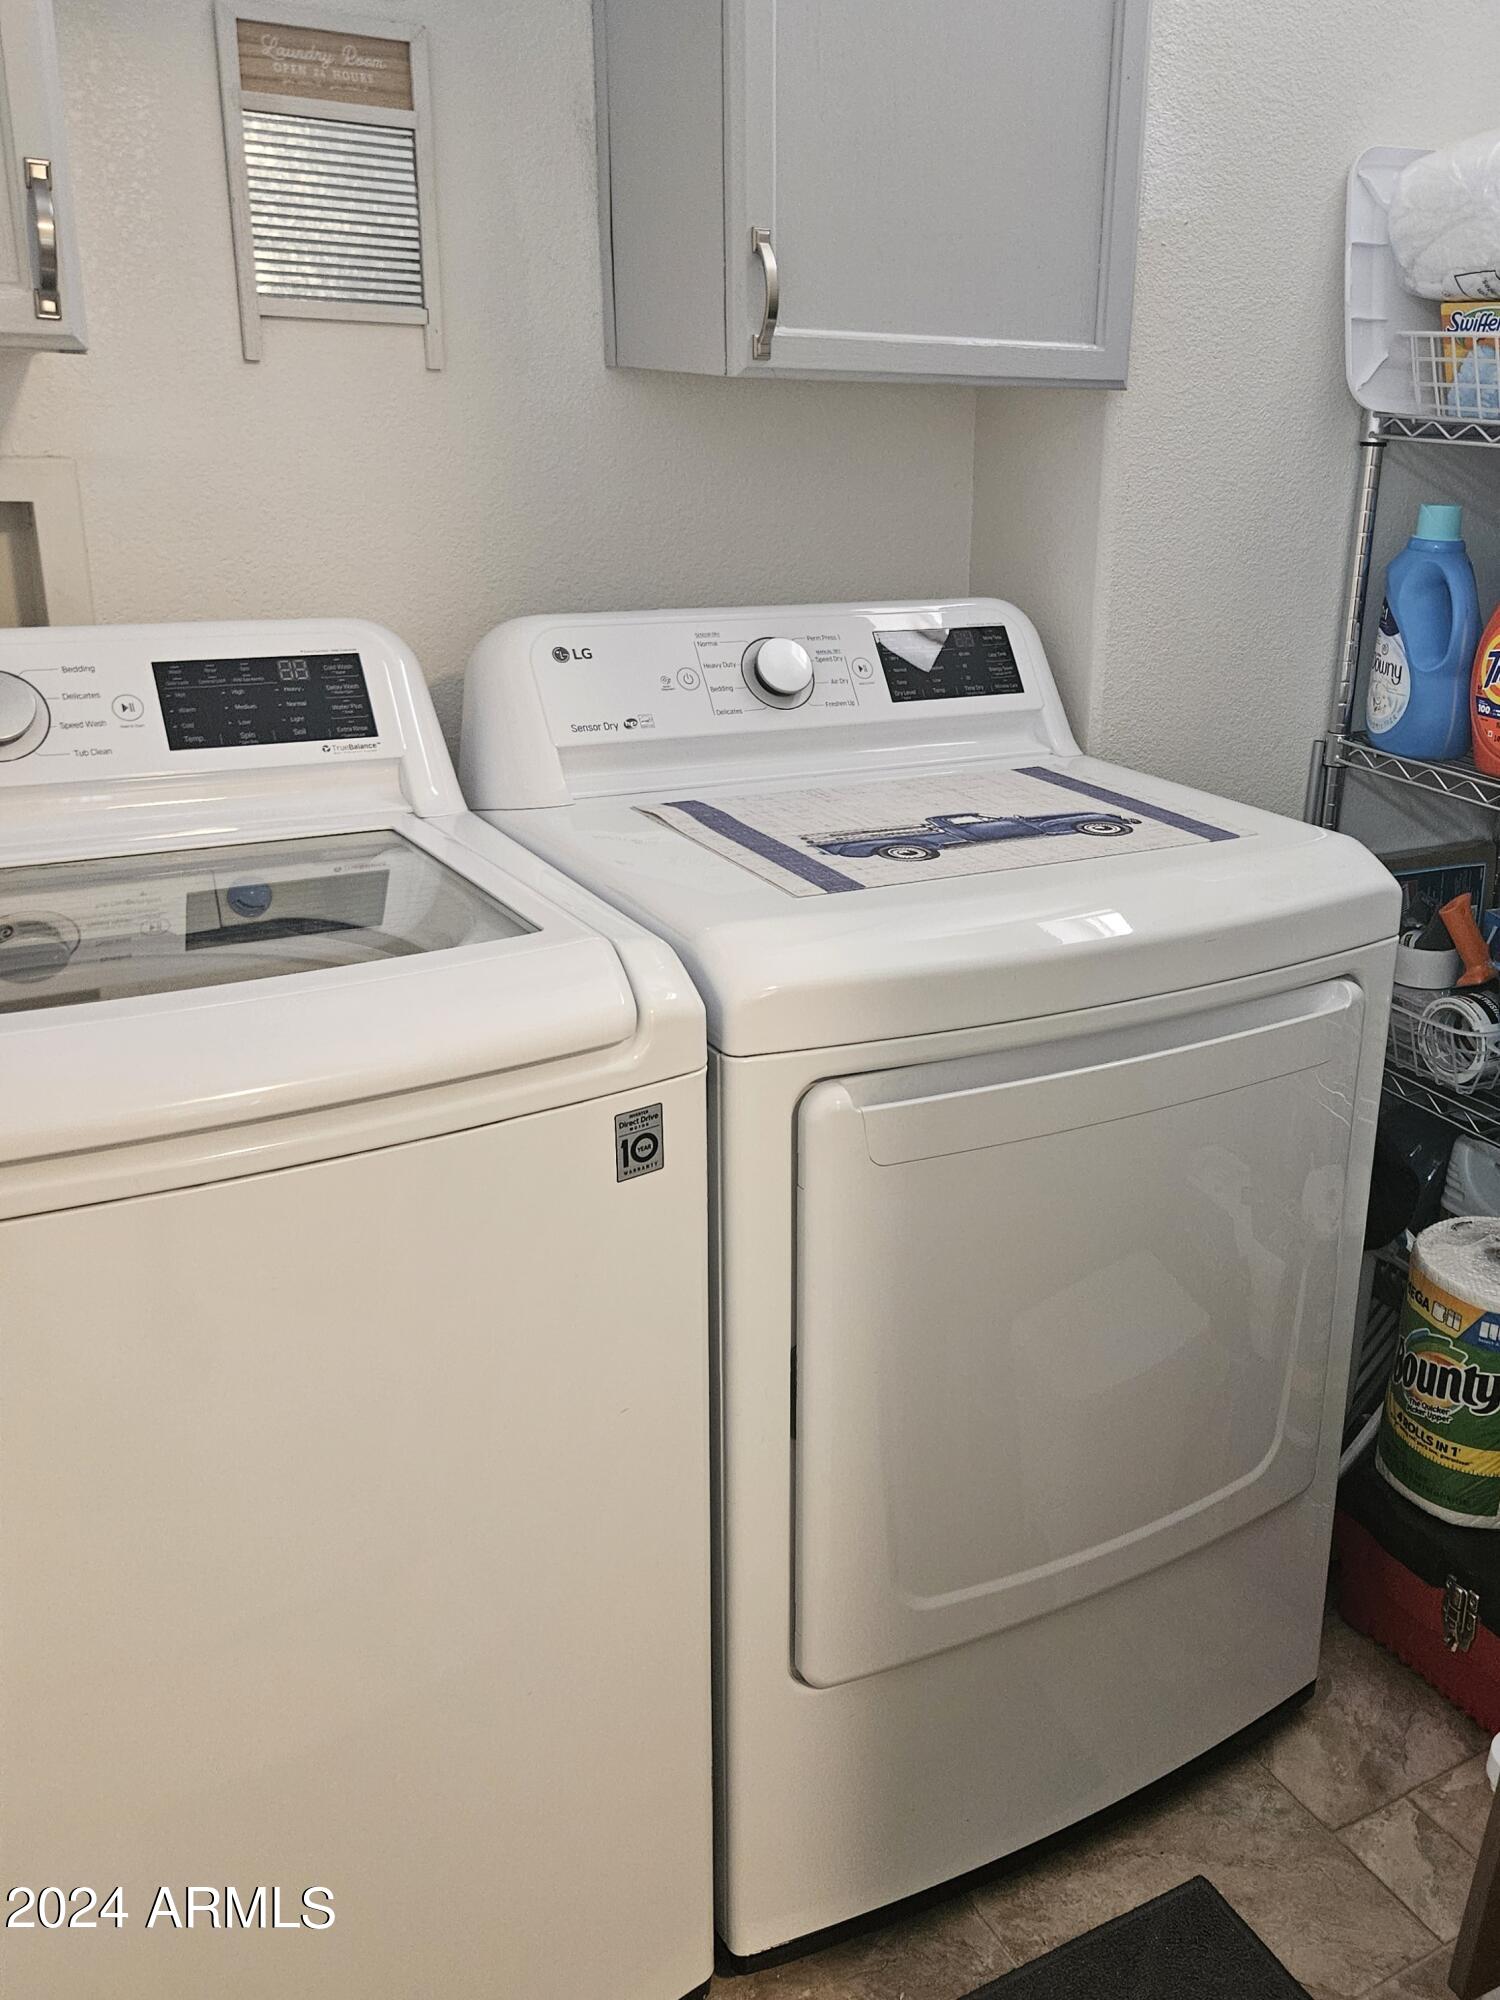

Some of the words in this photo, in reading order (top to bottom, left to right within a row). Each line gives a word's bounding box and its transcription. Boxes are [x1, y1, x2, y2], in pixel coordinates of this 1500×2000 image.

[261, 34, 334, 69] Laundry
[341, 45, 386, 69] Room
[272, 62, 306, 76] OPEN
[332, 70, 375, 84] HOURS
[572, 648, 593, 660] LG
[61, 665, 96, 673] Bedding
[62, 692, 100, 700] Delicates
[1478, 703, 1490, 714] 100
[60, 721, 84, 730] Speed
[86, 720, 107, 728] Wash
[570, 723, 601, 733] Sensor
[603, 722, 619, 731] Dry
[74, 749, 89, 757] Tub
[91, 748, 112, 756] Clean
[619, 1119, 639, 1129] Direct
[641, 1113, 659, 1123] Drive
[621, 1132, 659, 1168] 10
[637, 1144, 652, 1152] YEAR
[624, 1162, 658, 1175] WARRANTY
[1409, 1398, 1421, 1406] The
[1422, 1402, 1450, 1415] Quicker
[1427, 1411, 1452, 1423] Upper
[1402, 1416, 1434, 1446] ROLLS
[1436, 1440, 1448, 1453] IN
